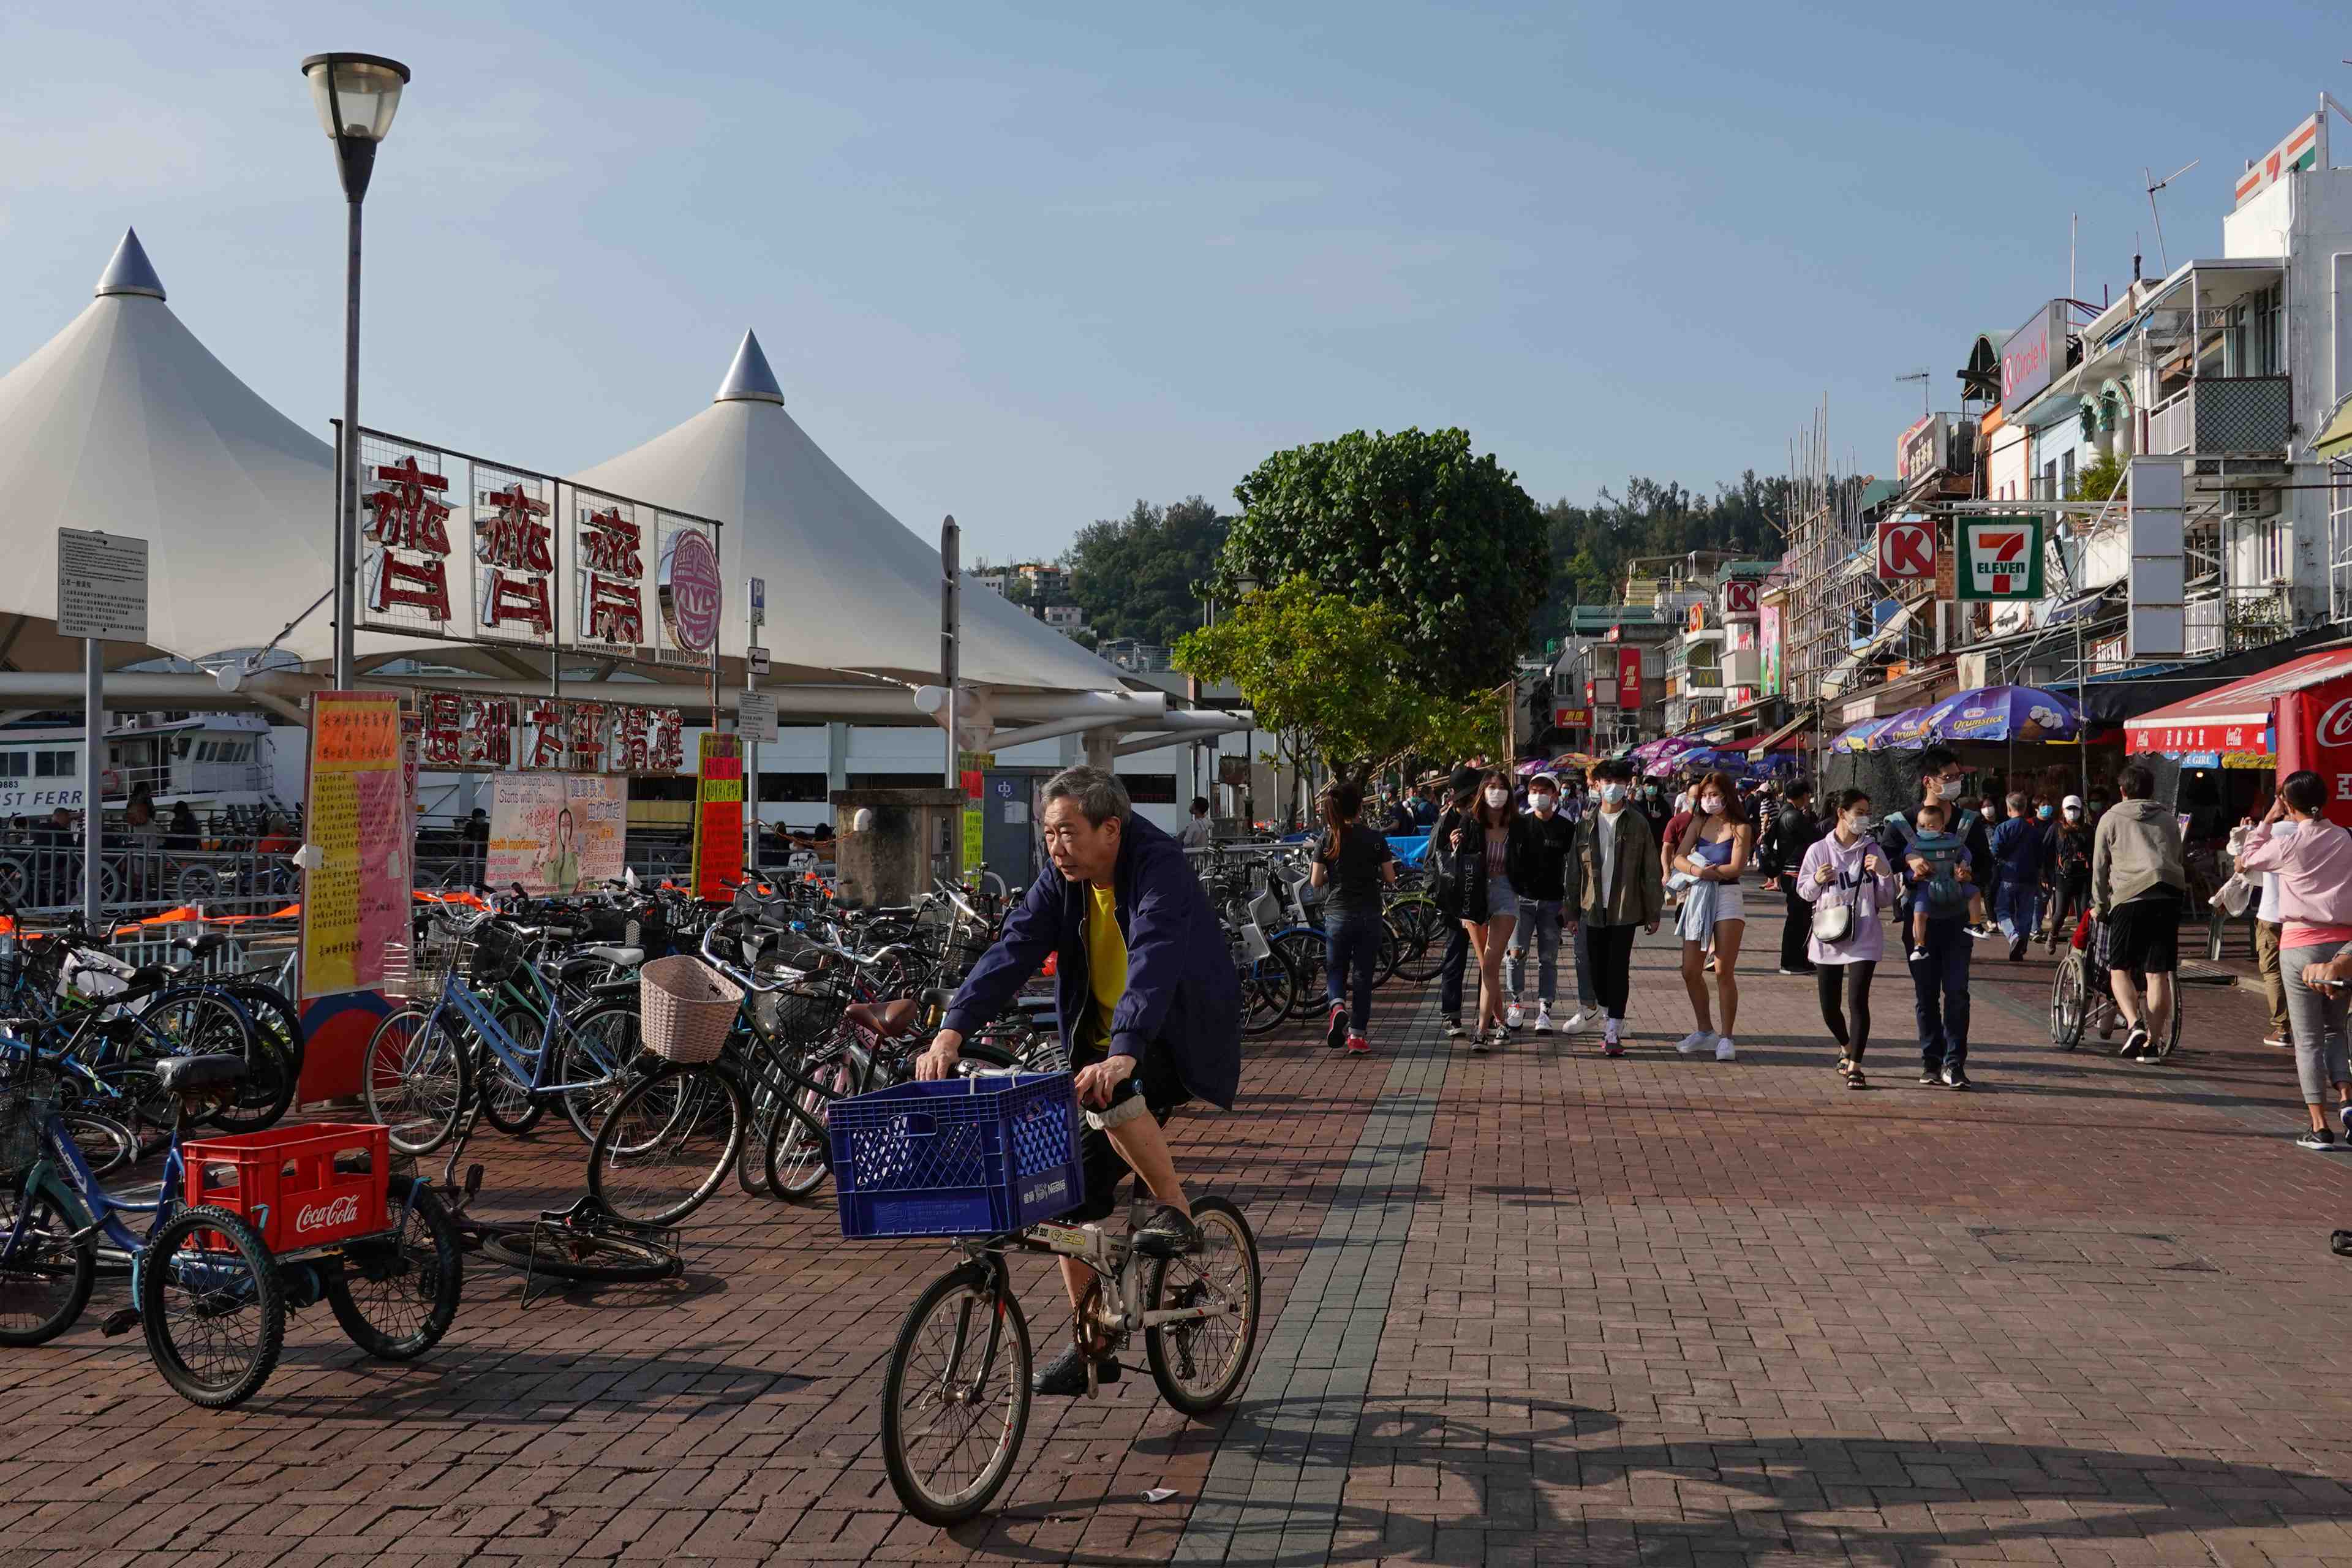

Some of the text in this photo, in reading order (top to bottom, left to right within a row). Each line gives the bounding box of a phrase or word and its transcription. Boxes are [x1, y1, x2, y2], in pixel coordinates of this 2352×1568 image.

[2015, 339, 2039, 384] Circle
[2041, 330, 2049, 363] K
[1891, 530, 1929, 570] K
[1978, 533, 2024, 594] 7
[754, 580, 763, 605] P
[1733, 586, 1754, 608] K
[1954, 715, 2005, 730] Drumstick
[0, 790, 83, 806] ST FERR
[499, 788, 519, 804] Starts
[520, 790, 533, 804] with
[1047, 1179, 1066, 1196] Nestlé
[296, 1194, 361, 1233] Coca-Cola
